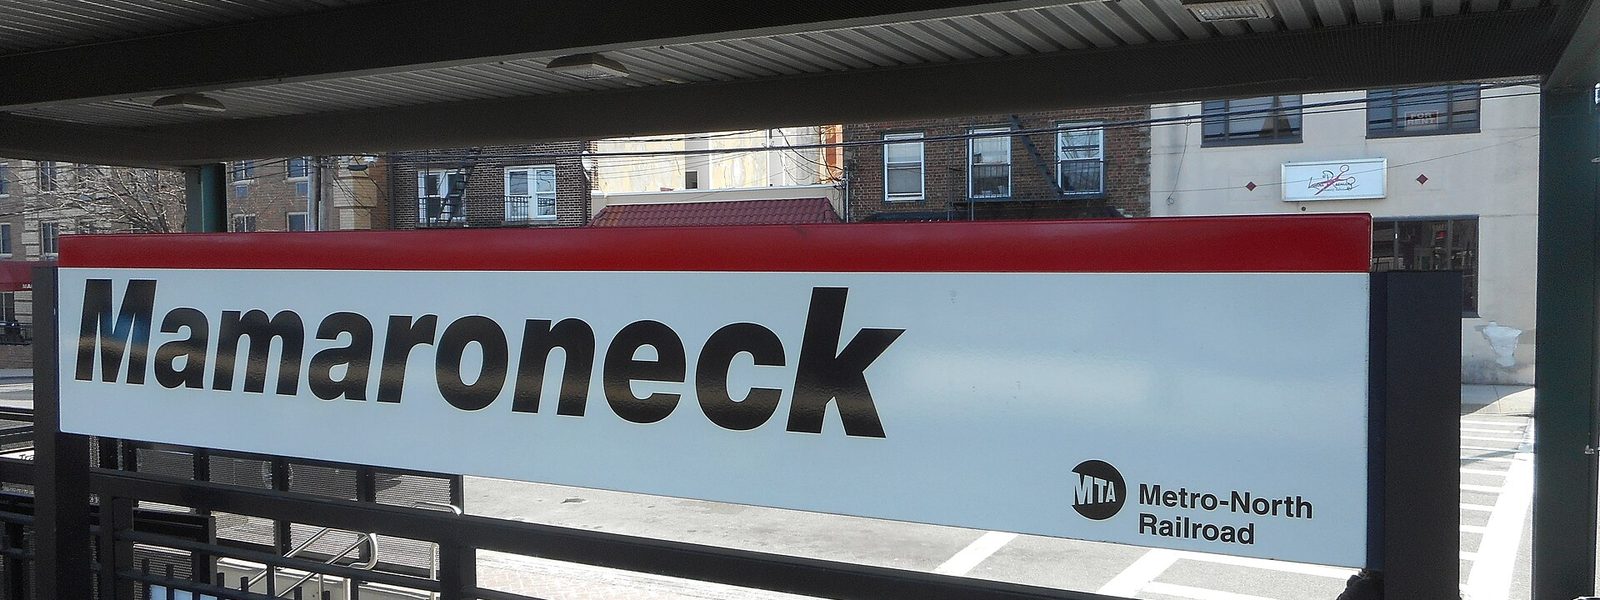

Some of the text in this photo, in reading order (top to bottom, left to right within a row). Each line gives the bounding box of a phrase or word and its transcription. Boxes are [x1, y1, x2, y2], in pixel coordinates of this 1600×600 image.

[1407, 118, 1436, 126] RENT
[75, 279, 905, 438] Mamaroneck
[1071, 472, 1118, 506] MTA
[1138, 483, 1313, 519] Metro-North
[1138, 513, 1255, 545] Railroad
